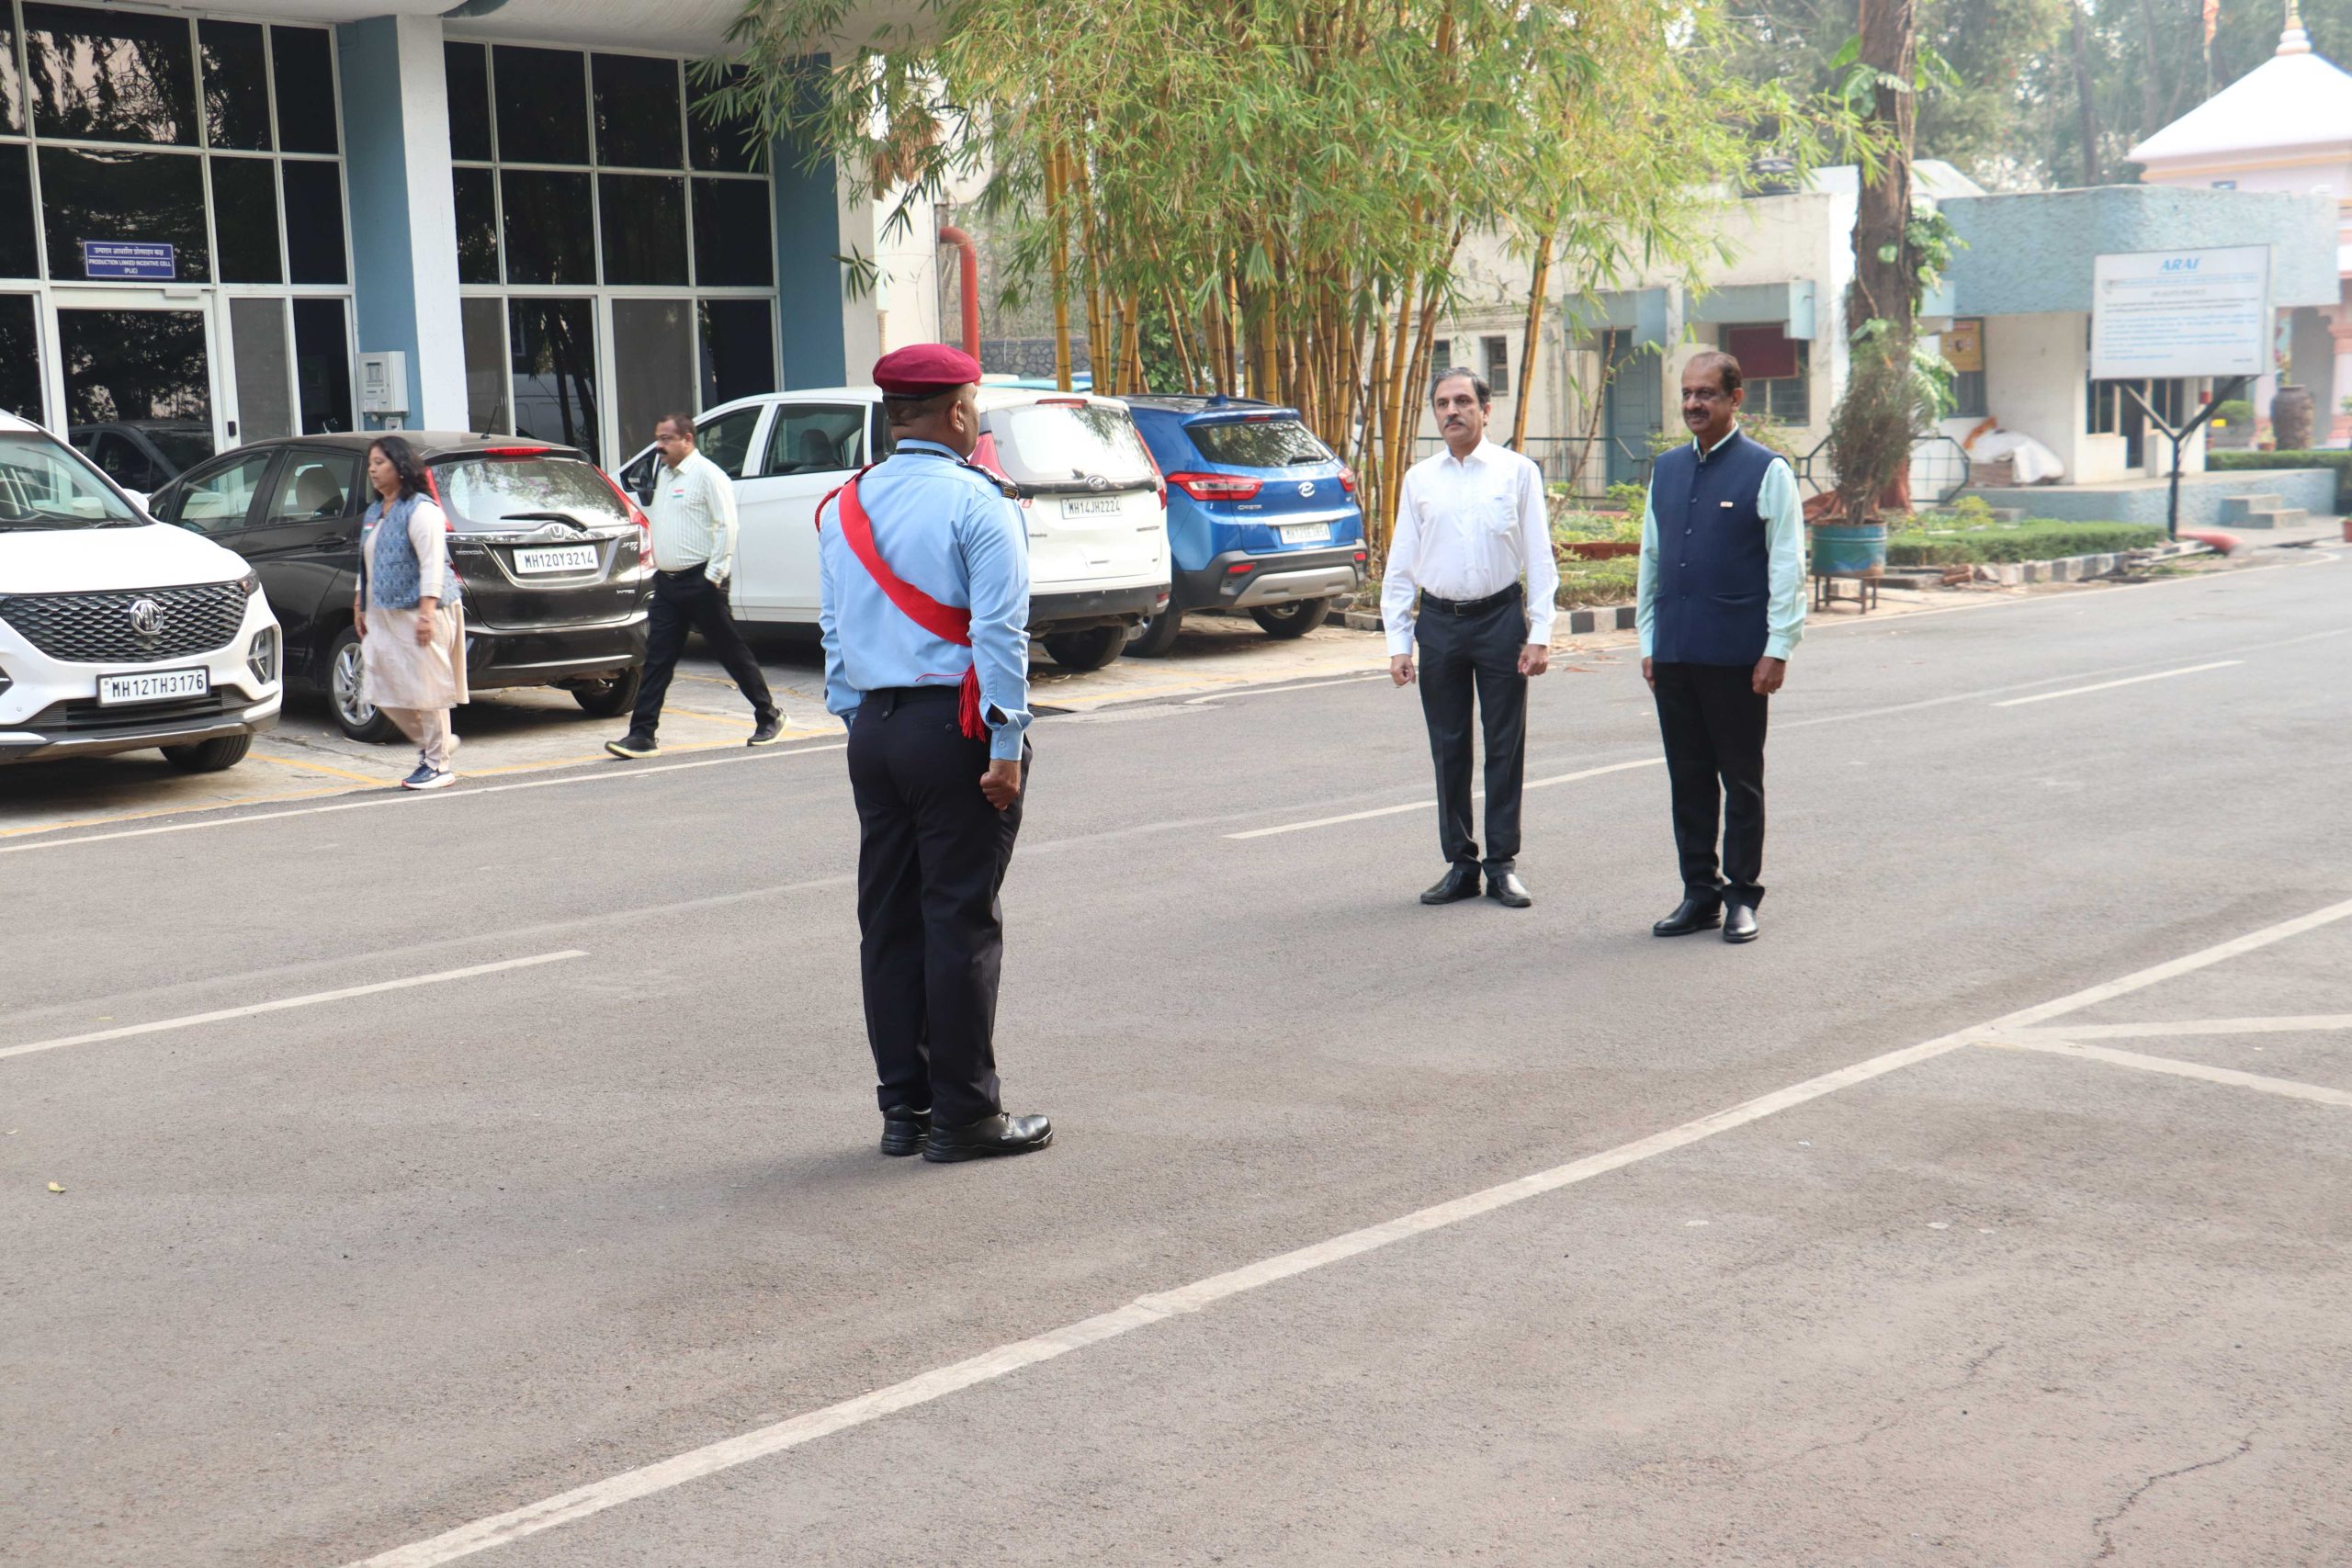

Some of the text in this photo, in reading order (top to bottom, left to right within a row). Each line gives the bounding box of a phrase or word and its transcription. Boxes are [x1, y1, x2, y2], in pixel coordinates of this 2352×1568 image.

[2160, 257, 2201, 272] ARAI
[1069, 500, 1121, 515] MH14JH2224
[524, 550, 594, 569] MH12QY3214
[131, 601, 164, 634] MG
[112, 673, 204, 698] MH12TH3176
